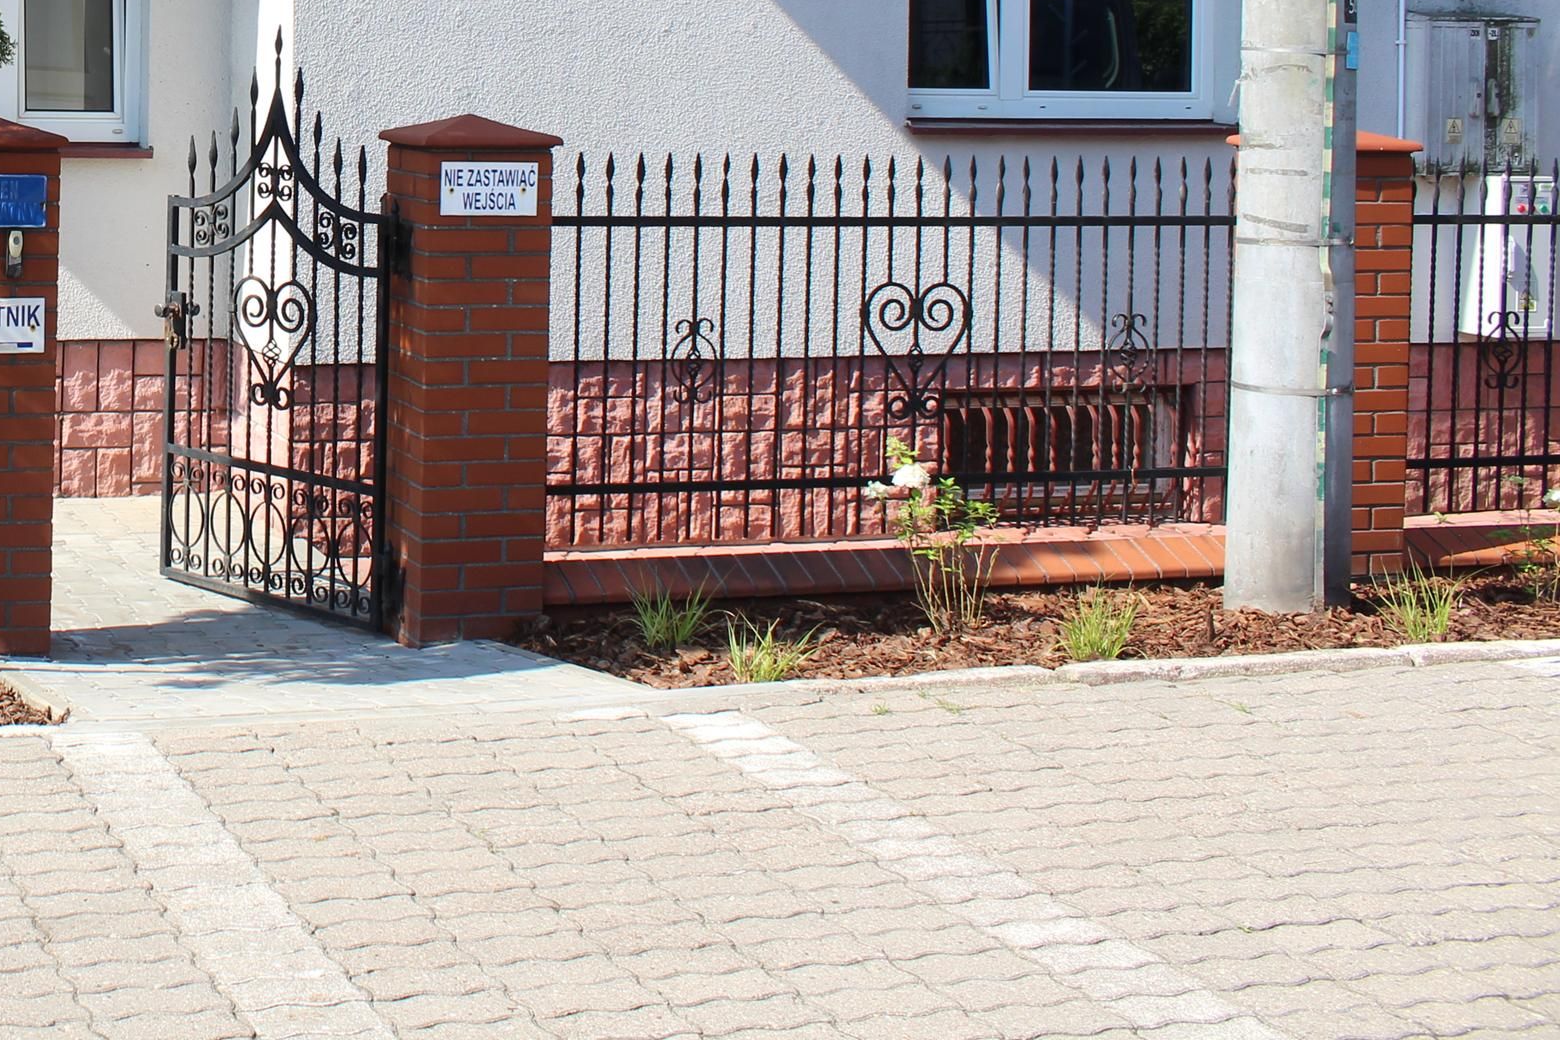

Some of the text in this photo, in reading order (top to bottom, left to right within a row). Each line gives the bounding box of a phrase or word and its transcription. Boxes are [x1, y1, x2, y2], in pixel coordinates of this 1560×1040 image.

[444, 165, 536, 187] NIE ZASTAWIAĆ
[462, 188, 516, 210] WEJŚCIA
